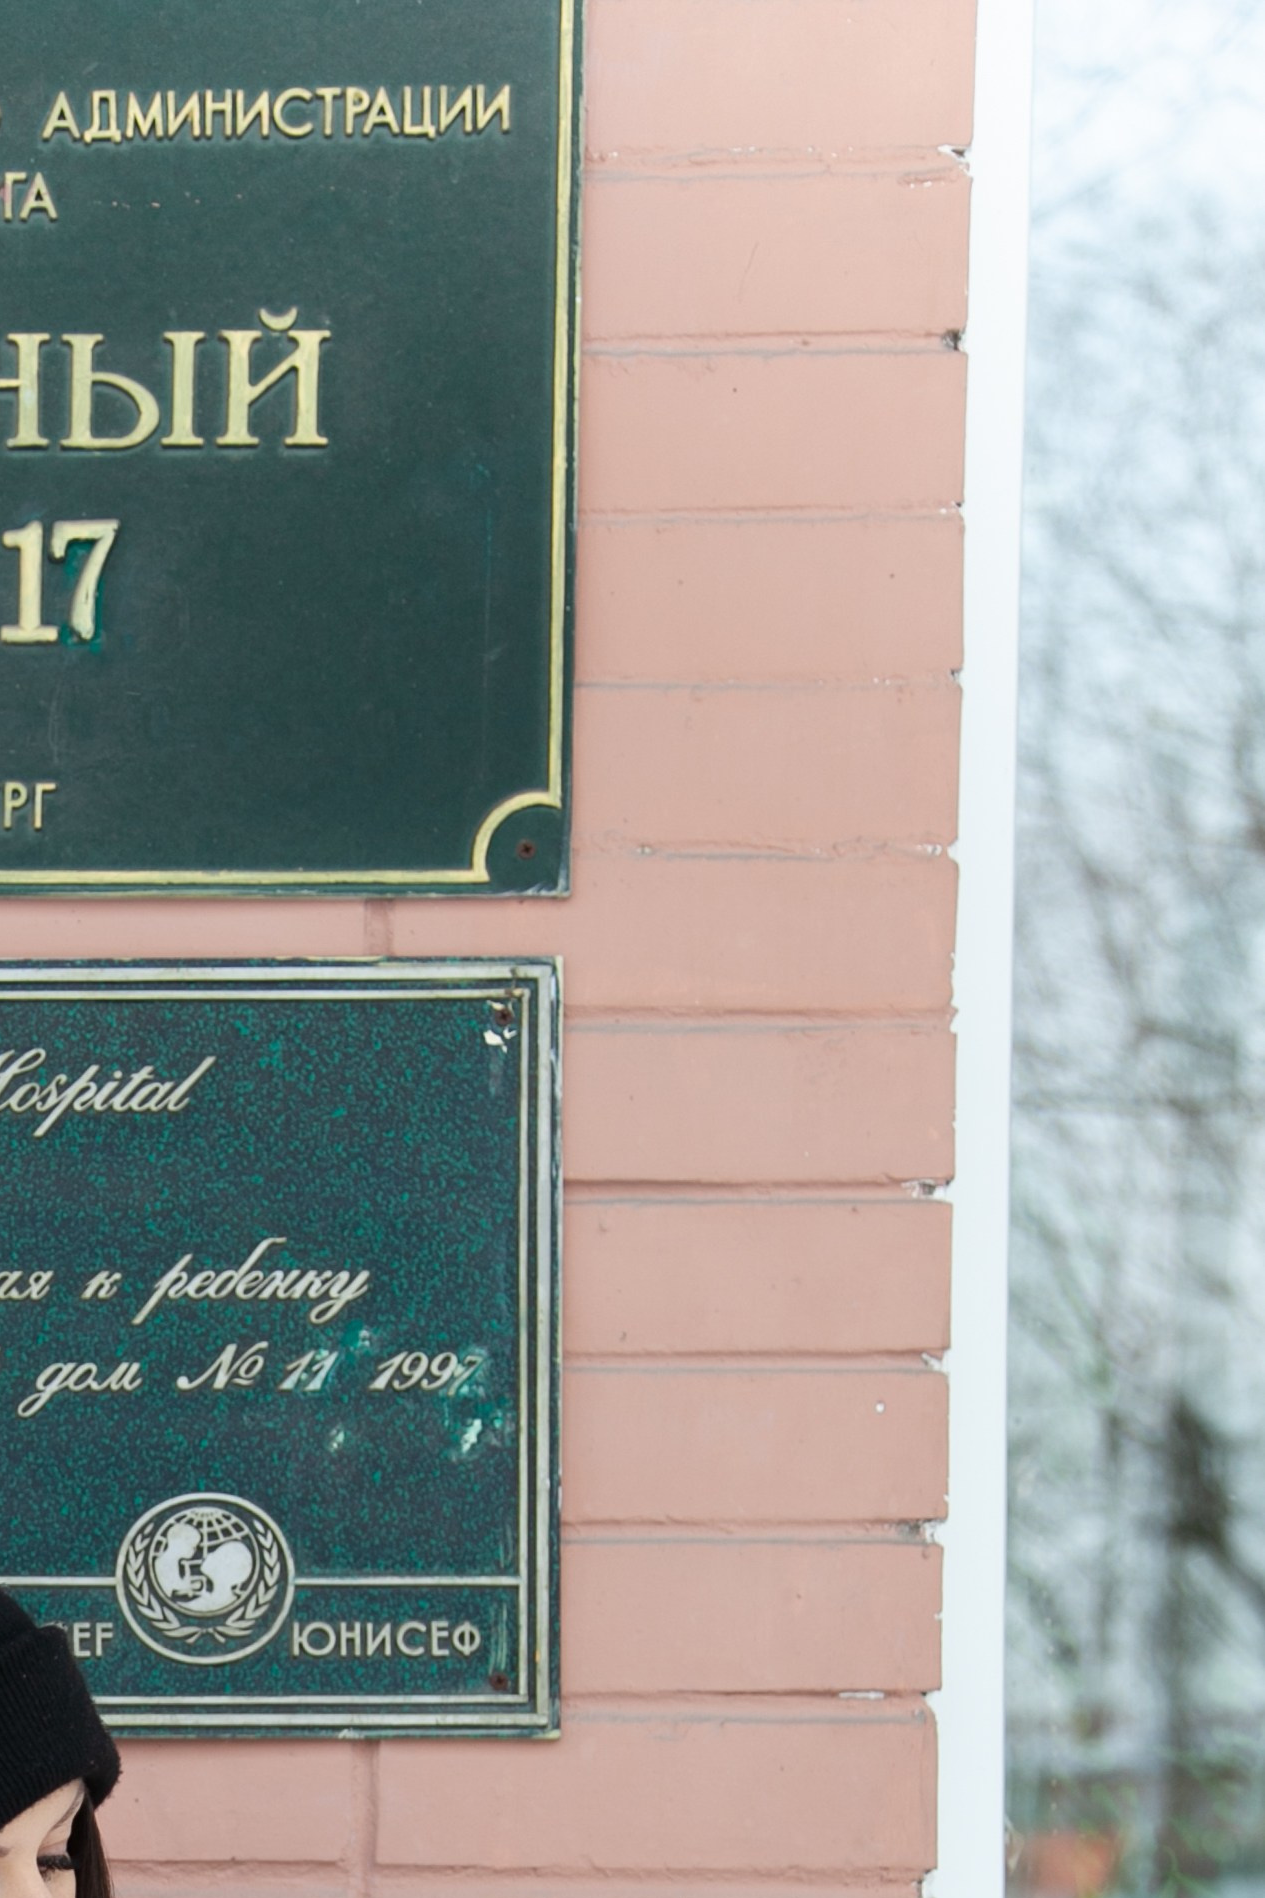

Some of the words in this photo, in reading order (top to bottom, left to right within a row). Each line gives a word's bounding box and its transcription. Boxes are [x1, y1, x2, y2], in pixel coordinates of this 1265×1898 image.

[42, 83, 511, 143] АДМИНИСТРАЦИИ
[82, 1271, 122, 1299] к
[132, 1237, 370, 1325] ребенку
[17, 1362, 142, 1417] дом
[293, 1620, 481, 1656] ЮНИСЕФ
